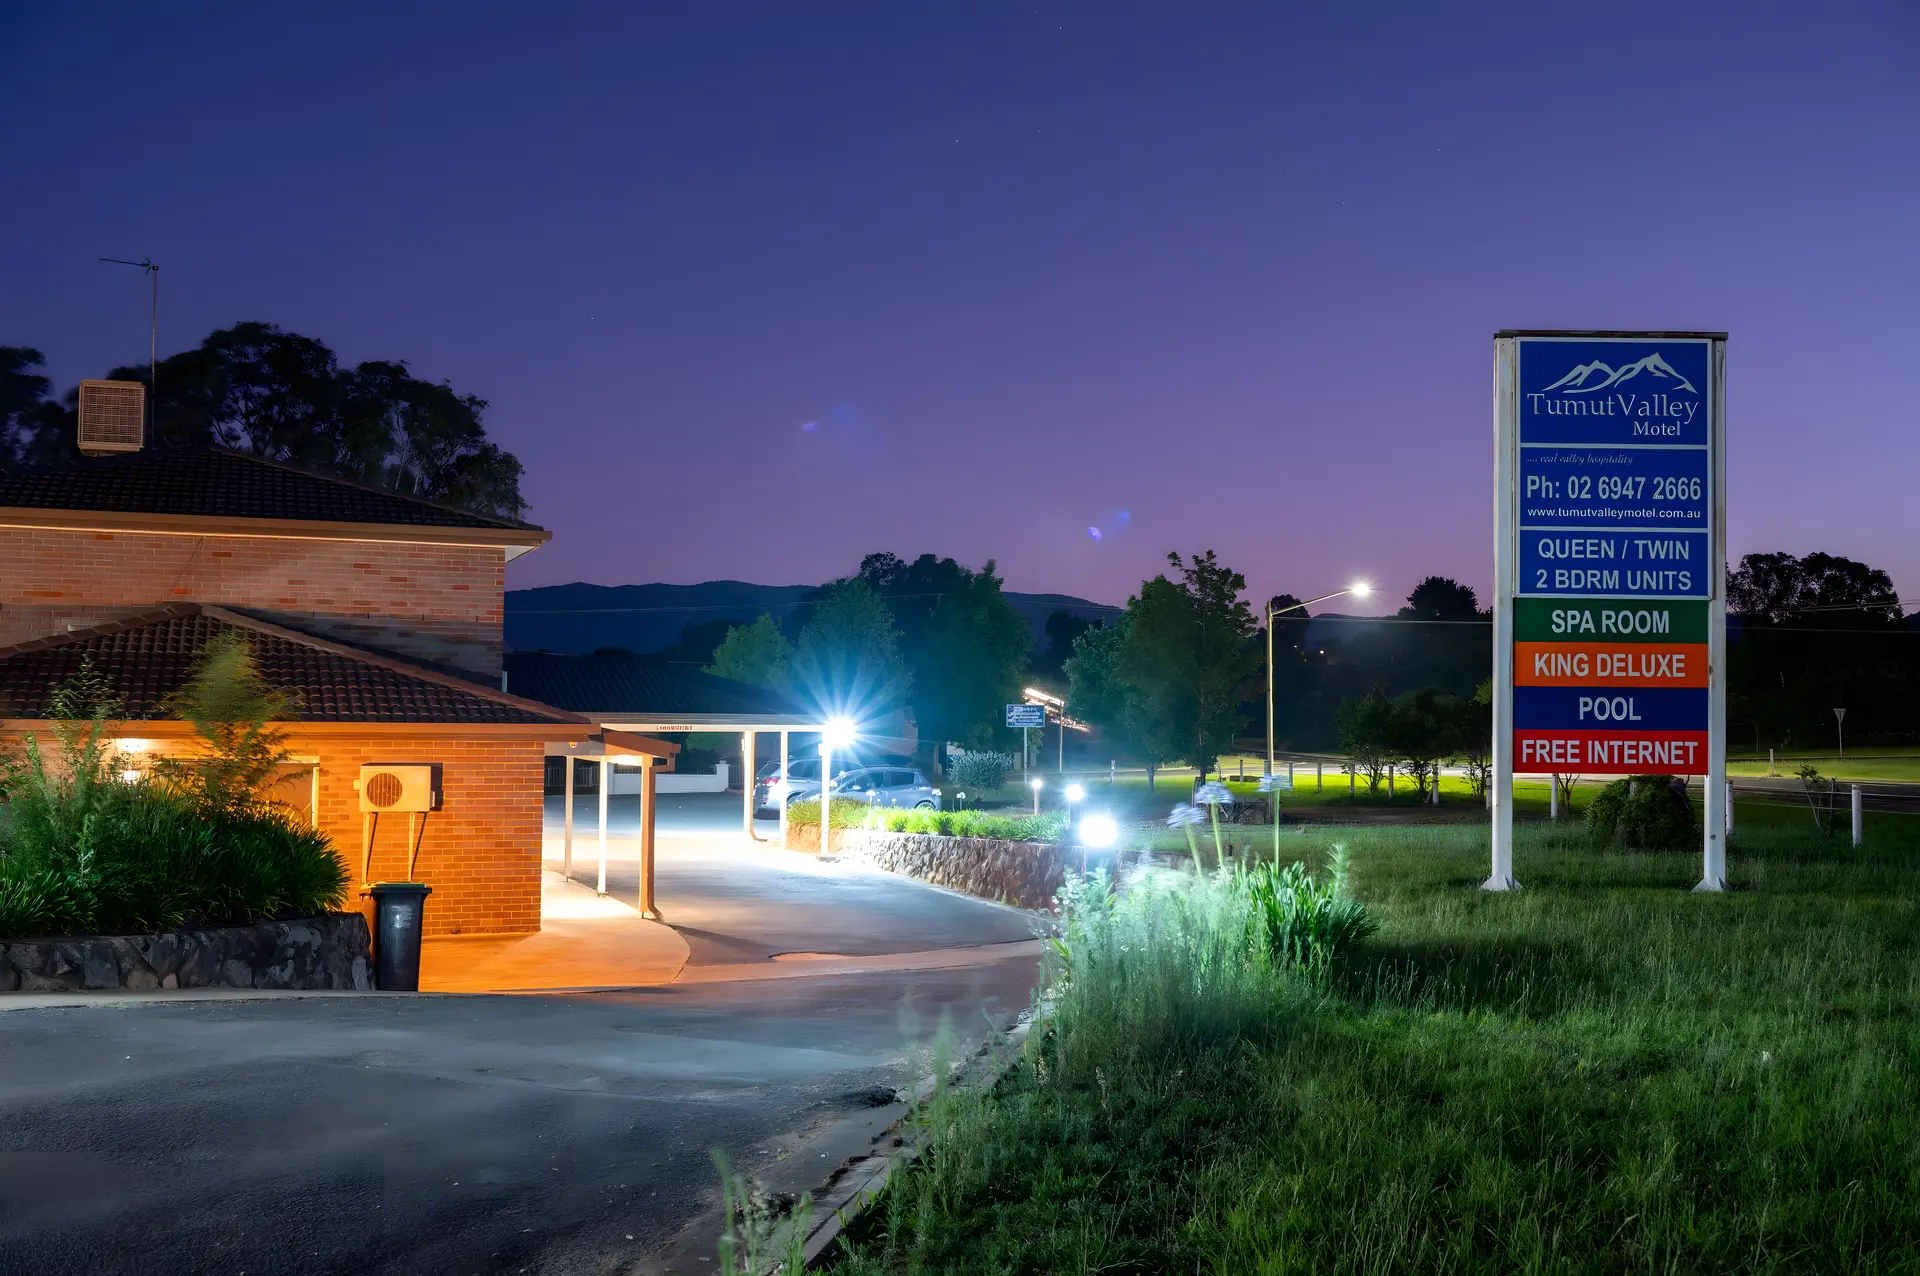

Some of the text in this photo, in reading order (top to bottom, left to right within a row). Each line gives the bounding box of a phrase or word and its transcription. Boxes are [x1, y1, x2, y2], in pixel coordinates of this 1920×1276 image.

[1632, 421, 1681, 436] Motel
[1527, 475, 1701, 501] Ph: 02 6947 2666
[1527, 507, 1701, 520] www.tumutvalleymotel.com.au
[1538, 538, 1615, 559] QUEEN
[1634, 540, 1690, 560] TWIN
[1536, 569, 1692, 591] 2 BDRM UNITS
[1551, 609, 1670, 634] SPA ROOM
[1534, 653, 1686, 678] KING DELUXE
[1579, 696, 1642, 721] POOL
[1522, 739, 1699, 765] FREE INTERNET
